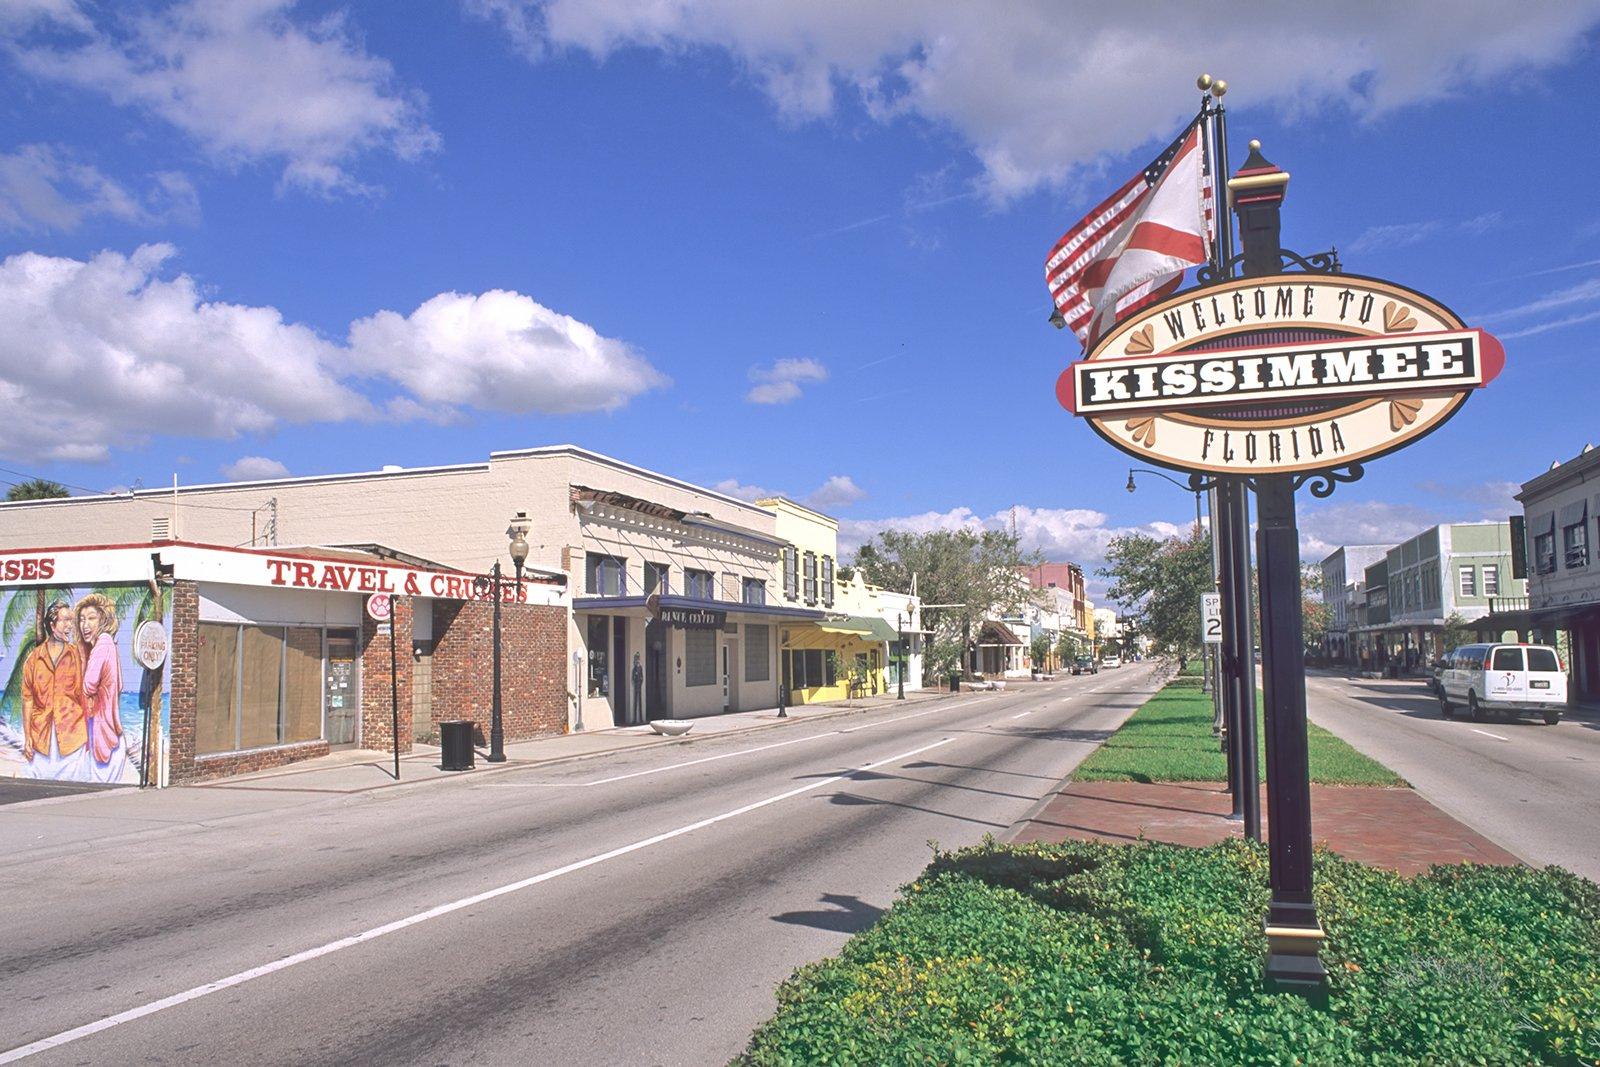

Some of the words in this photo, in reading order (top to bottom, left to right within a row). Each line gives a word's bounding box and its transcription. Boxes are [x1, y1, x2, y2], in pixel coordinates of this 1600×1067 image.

[1163, 285, 1315, 341] WELCOME
[1338, 288, 1375, 325] TO
[1090, 342, 1464, 403] KISSIMMEE
[1201, 420, 1347, 464] FLORIDA
[266, 559, 395, 592] TRAVEL
[404, 572, 422, 595] &
[430, 574, 528, 604] CRUES
[1207, 618, 1221, 635] 2
